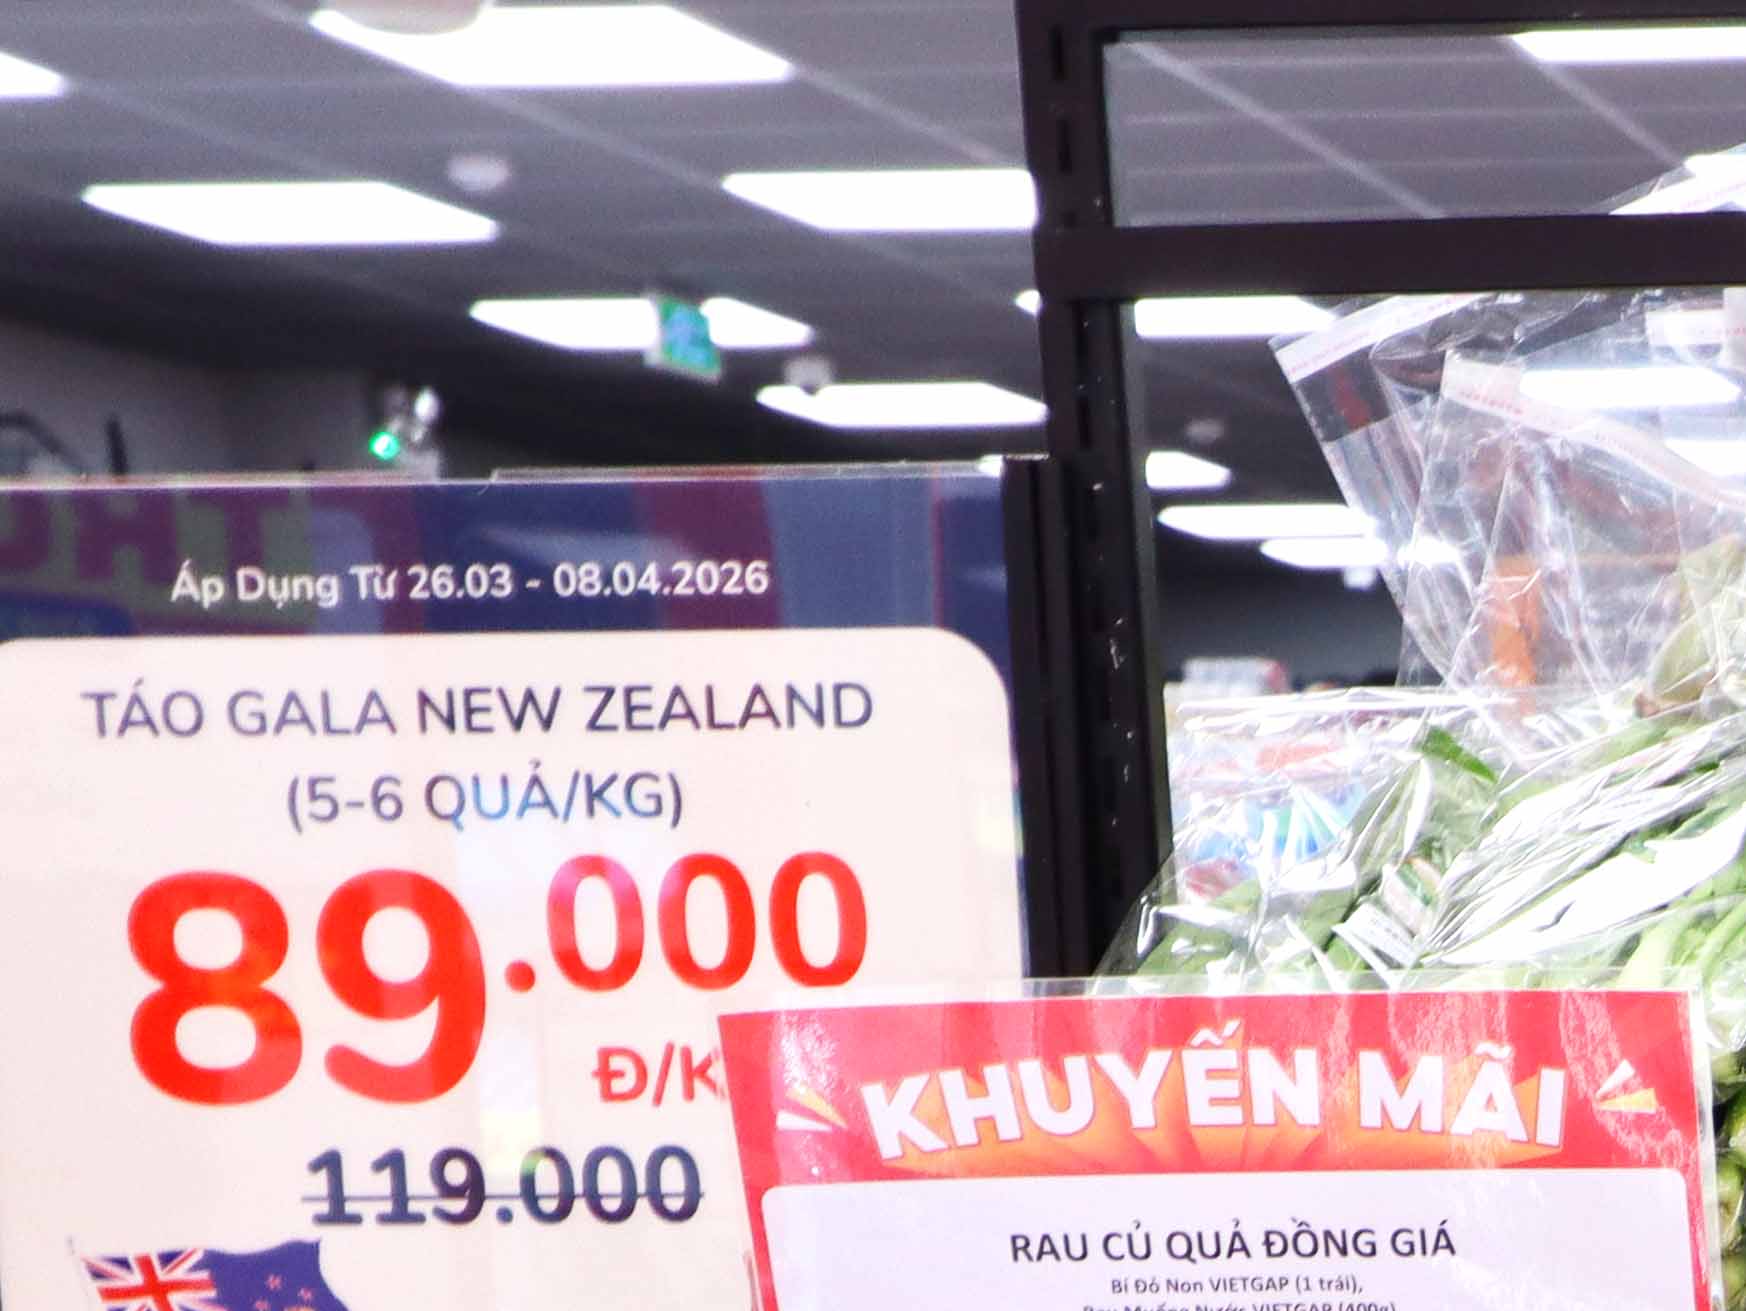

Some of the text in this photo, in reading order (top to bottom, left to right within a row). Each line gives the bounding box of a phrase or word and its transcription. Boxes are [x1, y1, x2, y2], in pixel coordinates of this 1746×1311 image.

[170, 561, 226, 609] Áp
[236, 566, 344, 609] Dụng
[347, 564, 398, 600] Từ
[407, 563, 514, 599] 26.03
[553, 558, 770, 597] 08.04.2026
[79, 678, 873, 738] TÁO GALA NEW ZEALAND
[287, 759, 683, 834] (5-6 QUẢ/KG)
[127, 851, 868, 1105] 89.000
[860, 1019, 1568, 1161] KHUYẾN MÃI
[306, 1146, 702, 1226] 119.000
[1010, 1218, 1457, 1264] RAU CỦ QUẢ ĐỒNG GIÁ
